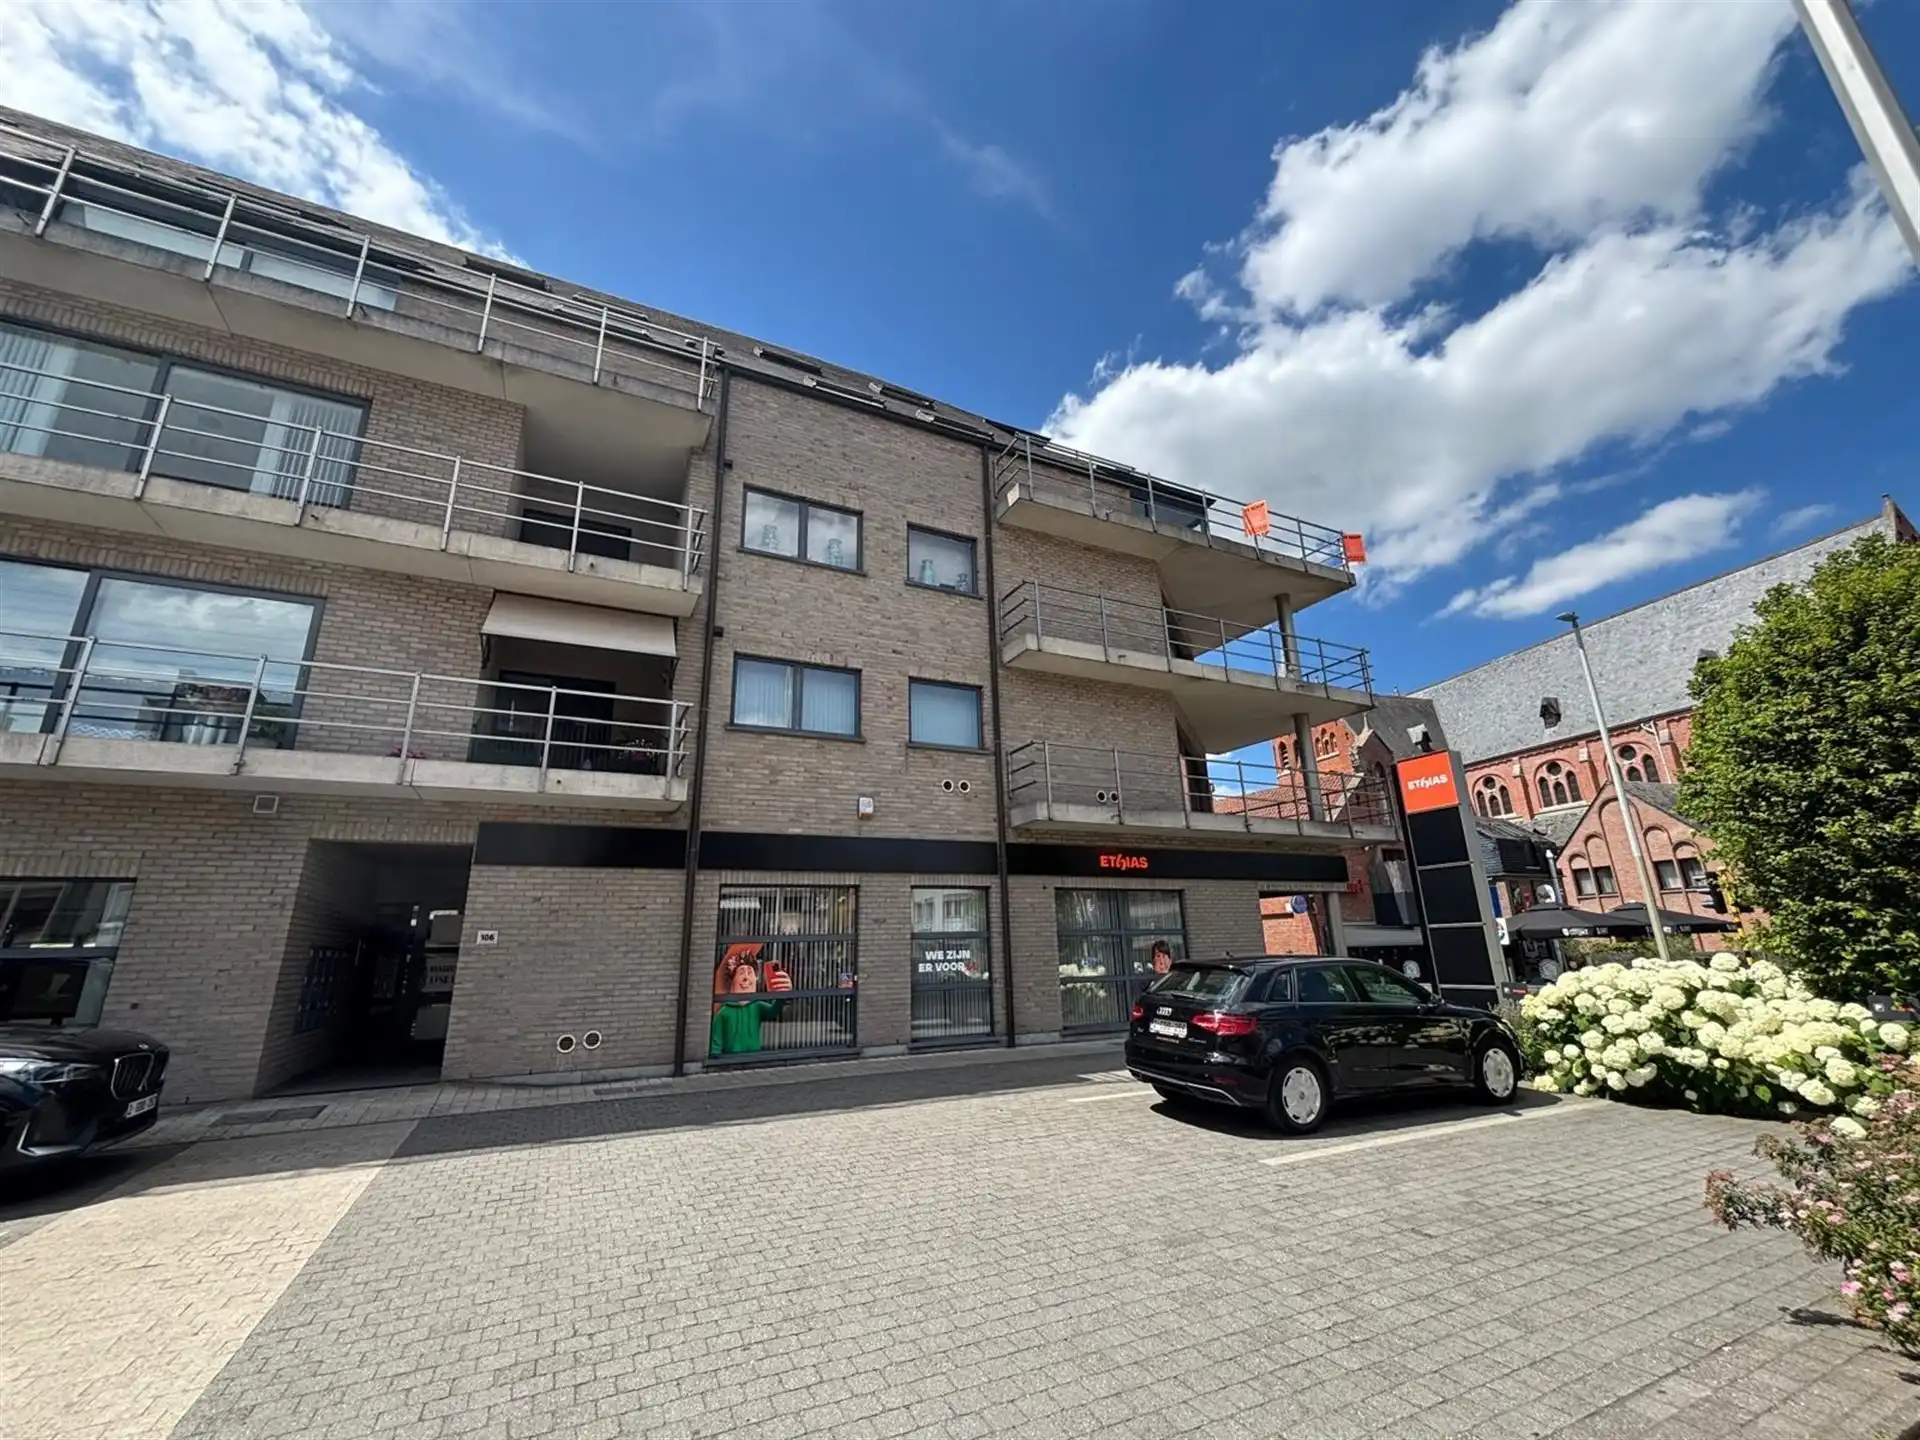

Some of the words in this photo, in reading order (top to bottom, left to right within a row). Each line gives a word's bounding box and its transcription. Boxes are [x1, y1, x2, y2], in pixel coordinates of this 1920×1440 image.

[480, 934, 496, 942] 106
[925, 950, 944, 960] WE
[946, 950, 971, 960] ZIJN
[918, 963, 933, 973] ER
[934, 961, 965, 972] VOOR
